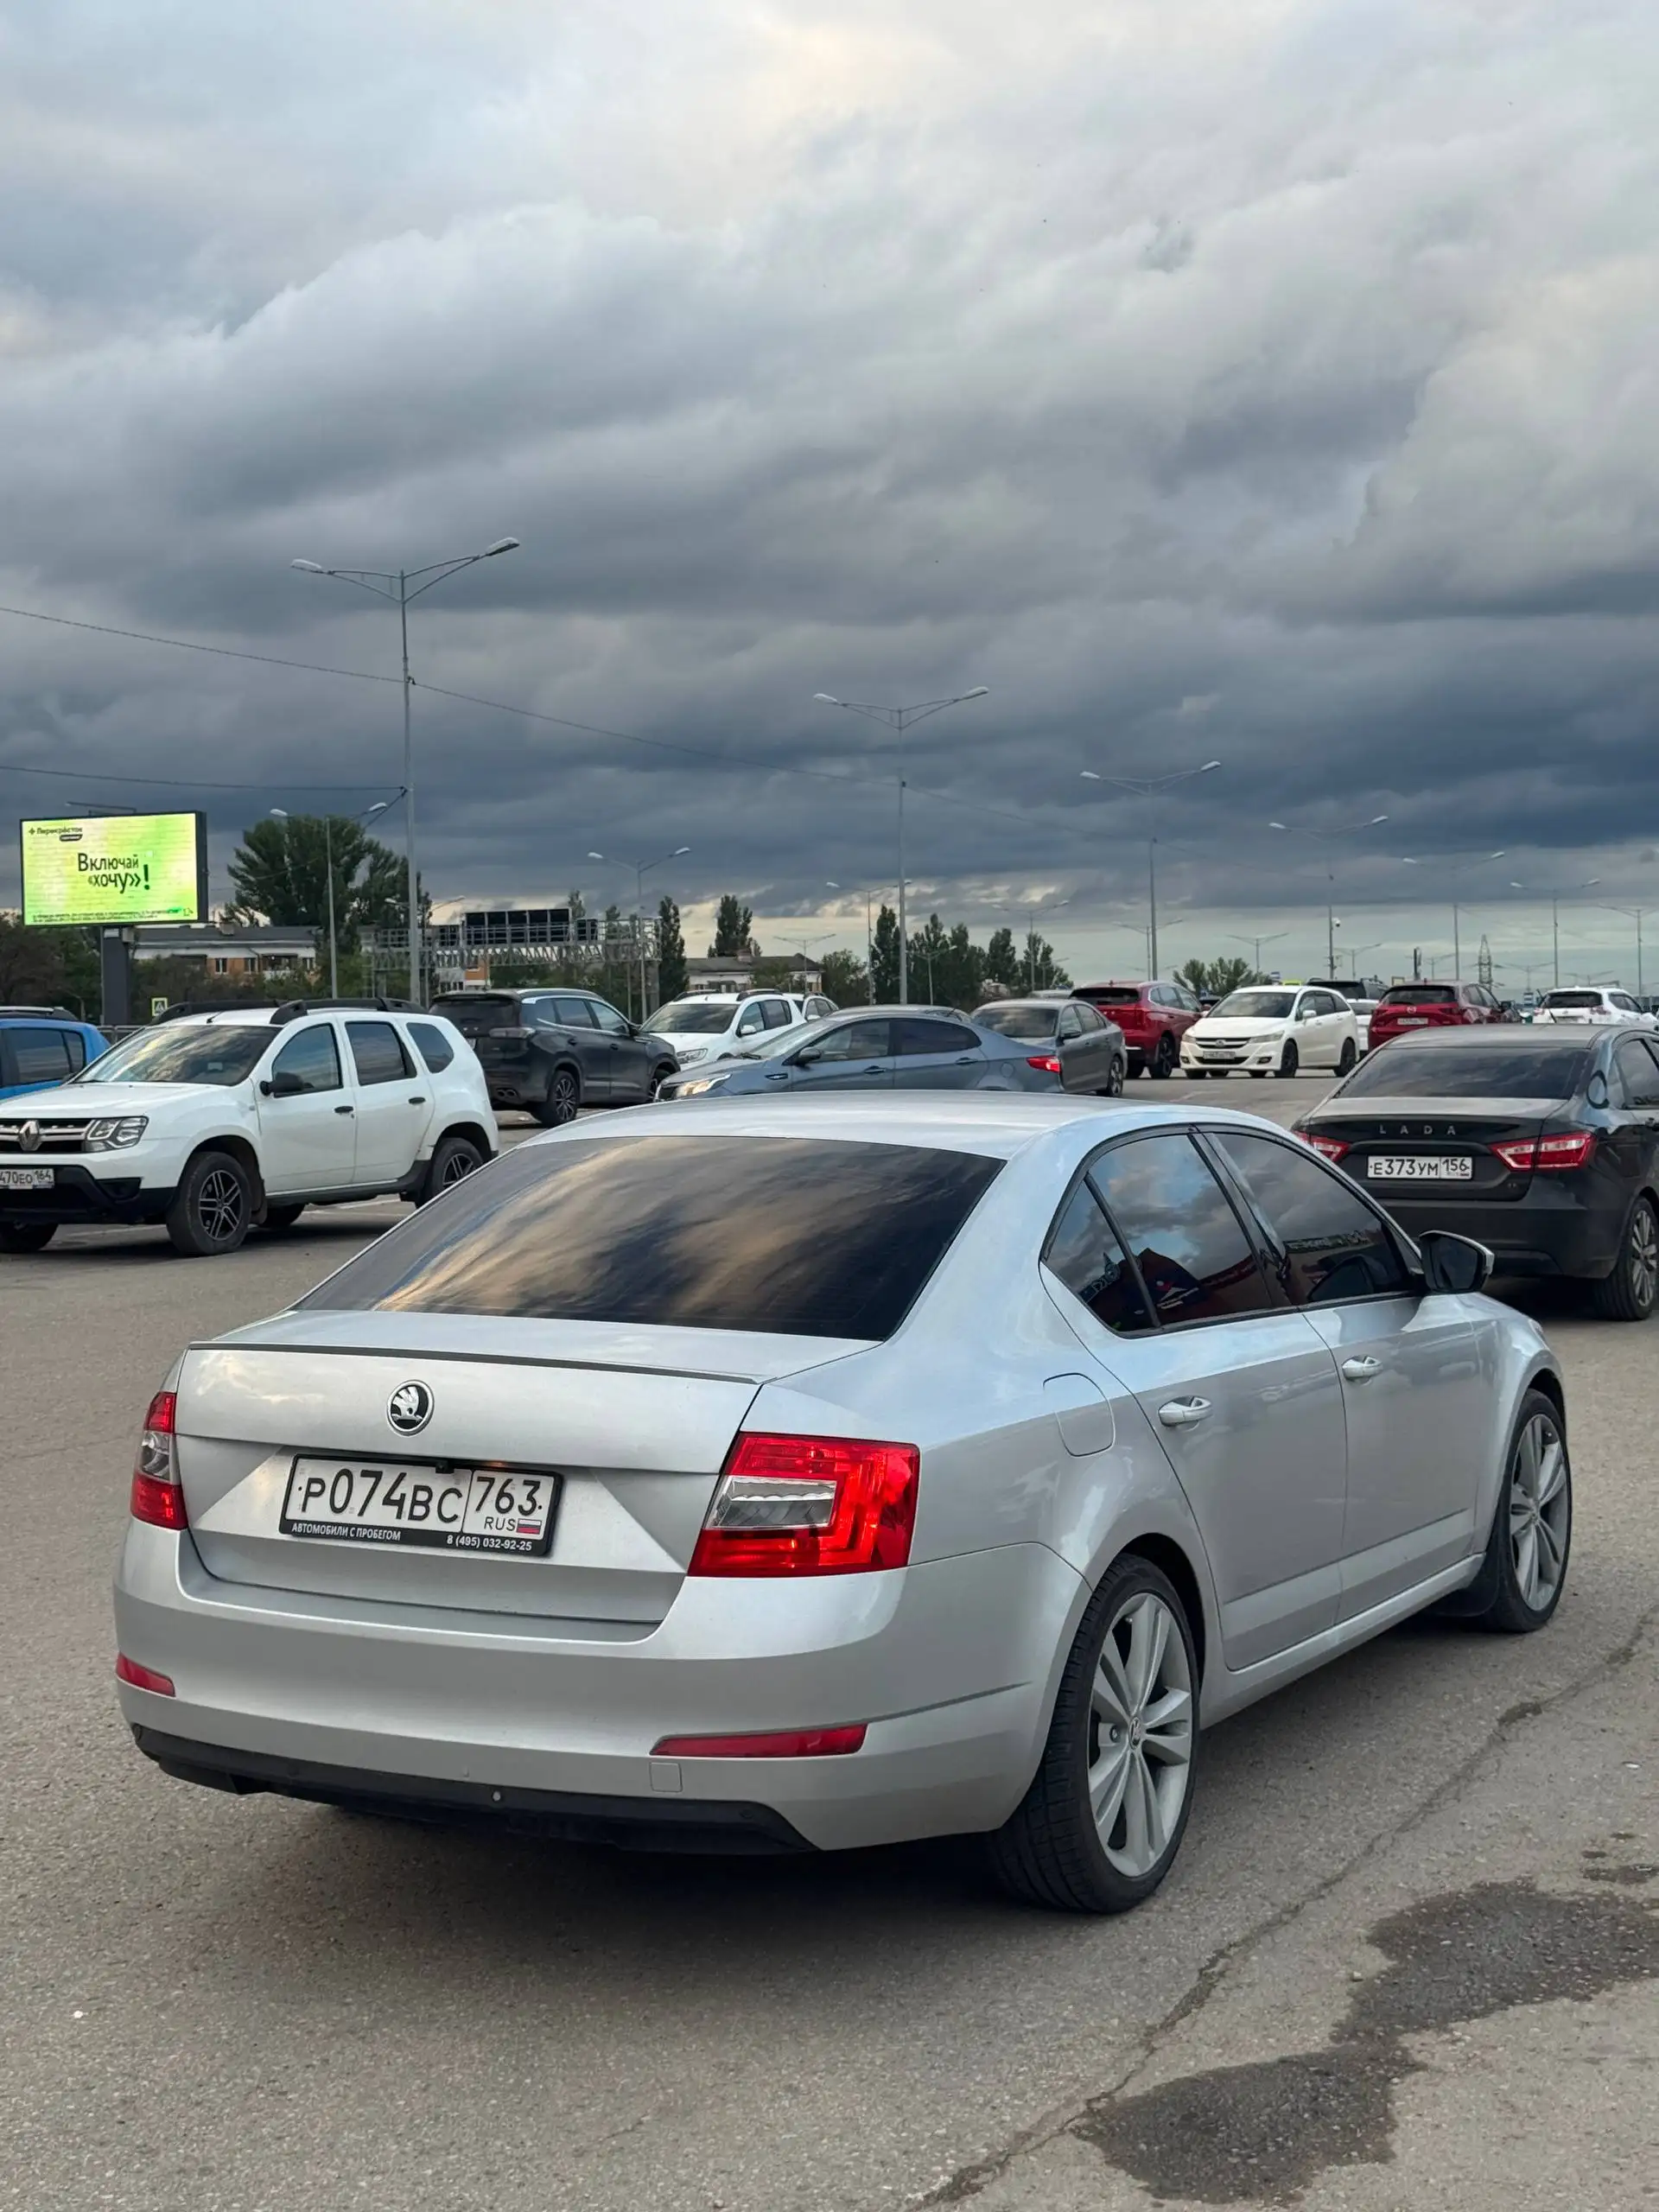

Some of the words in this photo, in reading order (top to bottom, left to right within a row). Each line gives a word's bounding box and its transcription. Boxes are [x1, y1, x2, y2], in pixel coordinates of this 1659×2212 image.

[78, 852, 139, 872] Включай
[1379, 1125, 1456, 1135] LADA
[1442, 1159, 1467, 1172] 156
[302, 1469, 462, 1523] Р074ВС
[475, 1476, 540, 1516] 763
[292, 1522, 348, 1537] АВТОМОБИЛИ
[349, 1527, 356, 1537] С
[356, 1528, 401, 1541] ПРОБЕГОМ
[484, 1516, 517, 1531] RUS
[447, 1535, 454, 1545] 8
[455, 1535, 480, 1548] (495)
[483, 1538, 533, 1551] 032-92-25
